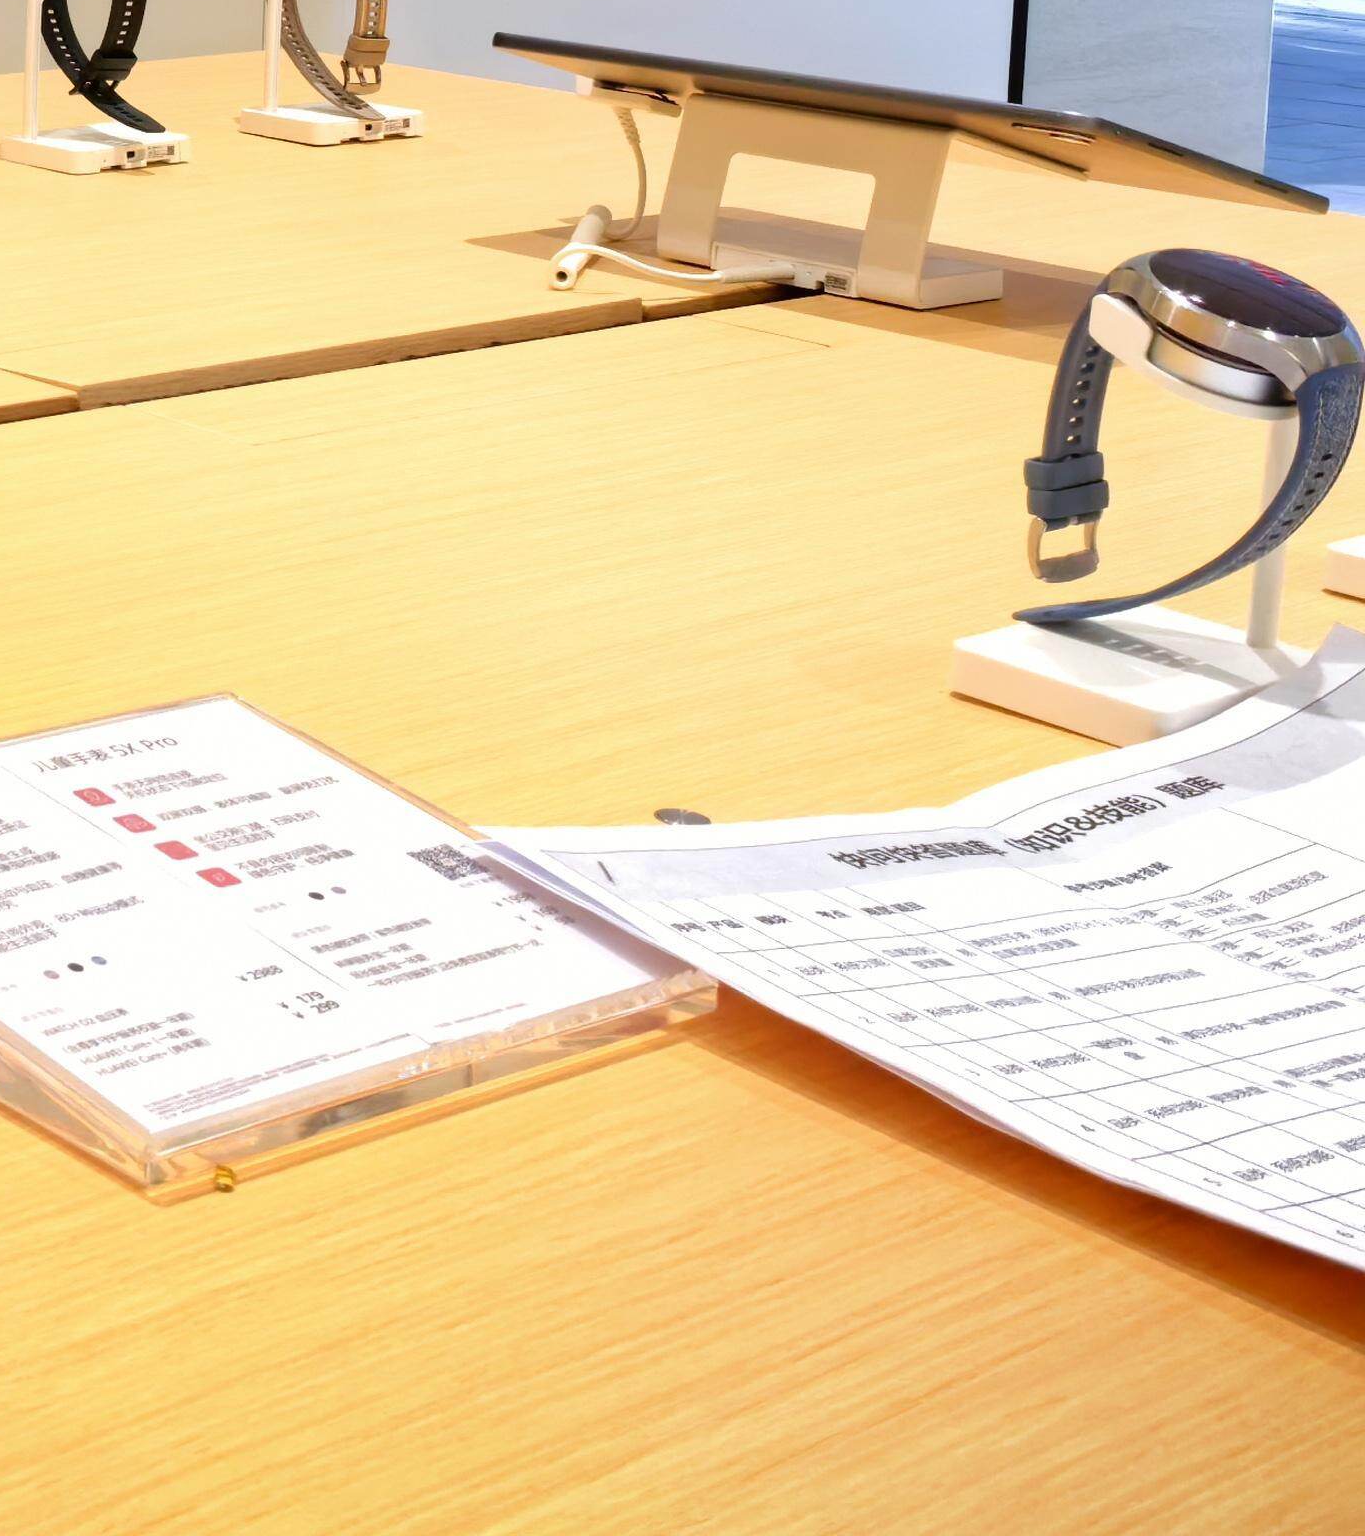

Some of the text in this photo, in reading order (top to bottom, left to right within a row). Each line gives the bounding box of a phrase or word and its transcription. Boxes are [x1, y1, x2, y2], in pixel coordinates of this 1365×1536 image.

[32, 737, 178, 773] 儿童手表 5X Pro
[295, 991, 324, 1003] 179
[310, 1000, 340, 1014] 299
[80, 1048, 125, 1065] HUAWEI
[95, 1058, 139, 1076] HUAWEI
